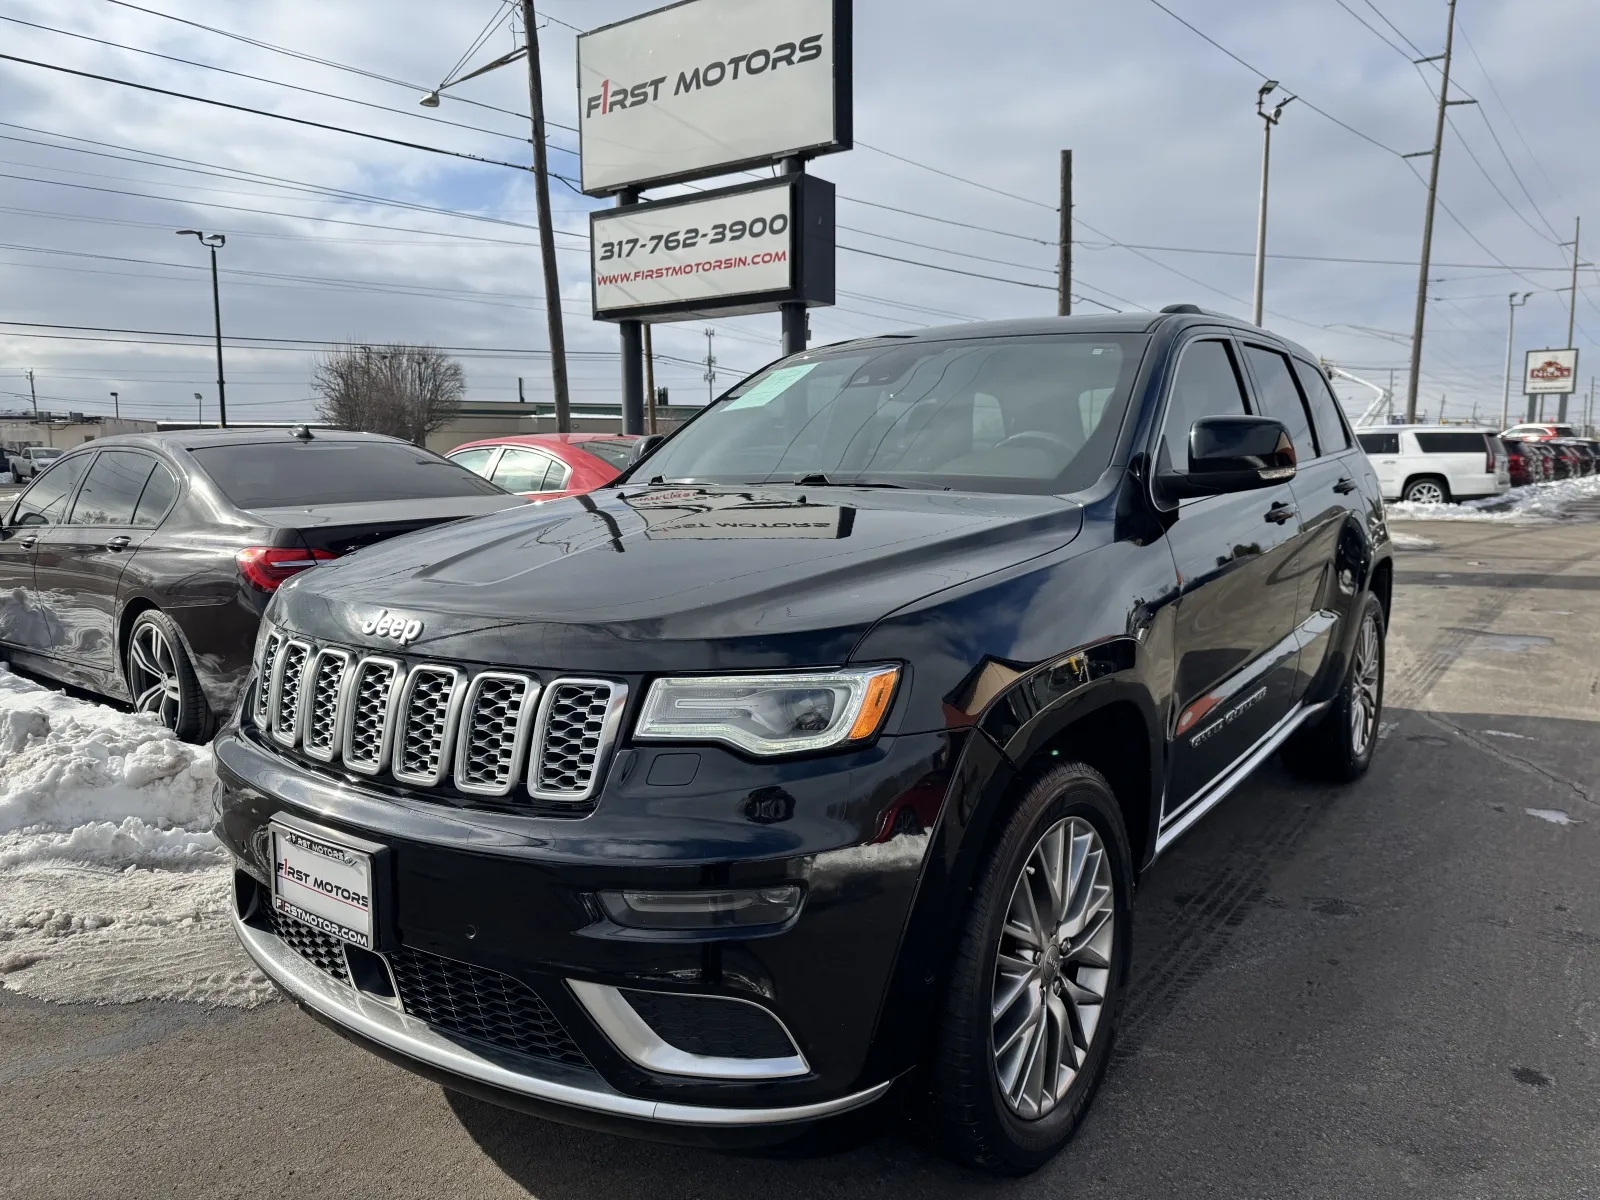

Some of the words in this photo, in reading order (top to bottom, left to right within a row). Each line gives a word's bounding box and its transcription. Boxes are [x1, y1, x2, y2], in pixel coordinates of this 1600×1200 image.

[673, 33, 824, 96] MOTORS
[599, 213, 788, 261] 317-762-3900
[597, 250, 787, 286] WWW.FIRSTMOTORSIN.COM
[361, 610, 424, 646] Jeep
[313, 876, 368, 907] MOTORS
